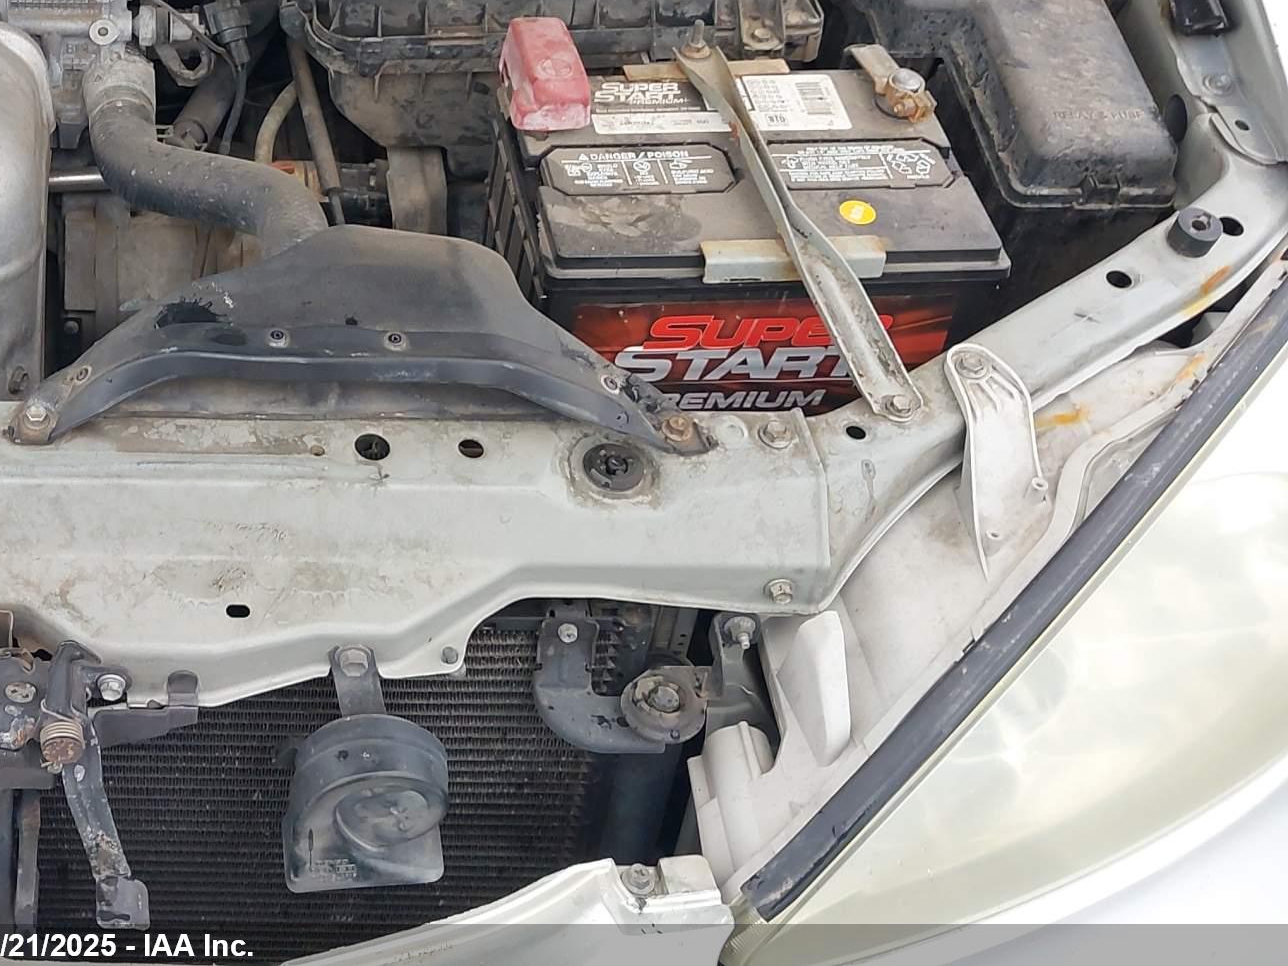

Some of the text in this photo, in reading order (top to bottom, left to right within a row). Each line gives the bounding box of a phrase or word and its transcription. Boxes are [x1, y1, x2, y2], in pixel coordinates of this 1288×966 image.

[601, 82, 679, 92] SUPER
[594, 90, 681, 103] START
[590, 152, 636, 160] DANGER
[647, 150, 689, 159] POISON
[643, 315, 893, 349] SUPE
